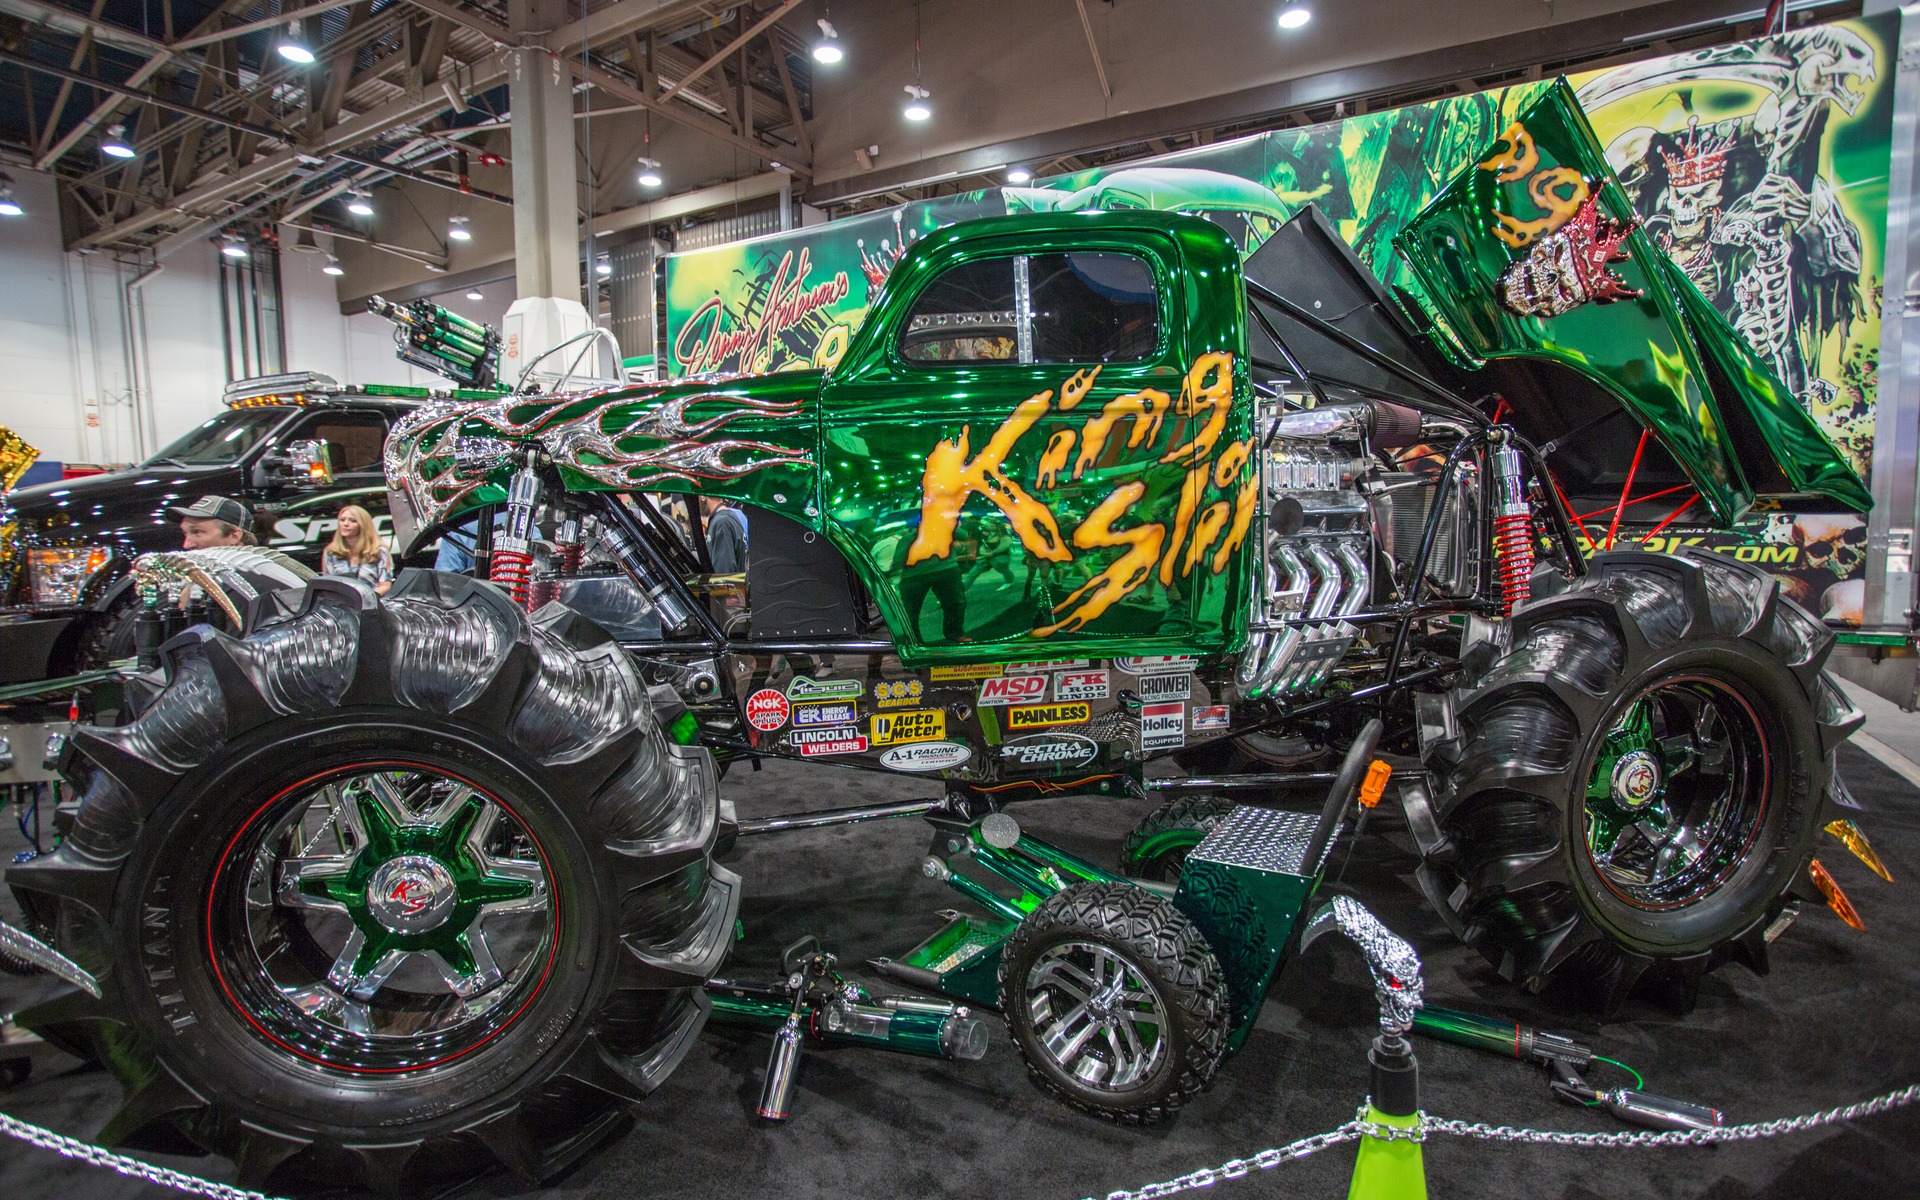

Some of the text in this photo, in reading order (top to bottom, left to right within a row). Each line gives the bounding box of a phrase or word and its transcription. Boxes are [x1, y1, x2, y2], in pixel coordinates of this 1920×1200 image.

[905, 350, 1234, 567] King
[953, 665, 1001, 673] SUSPENSIN
[1148, 665, 1191, 673] transmissions
[982, 676, 1045, 697] MSD
[1061, 673, 1107, 687] FK
[1140, 675, 1190, 695] CROWER
[877, 681, 922, 698] SCS
[1068, 684, 1107, 692] ROD
[877, 696, 922, 708] GEARBOX
[1057, 691, 1107, 701] ENDS
[1161, 691, 1190, 700] PRODUCTS
[753, 698, 782, 710] NGK
[821, 705, 849, 715] ENERGY
[755, 711, 781, 719] SPARK
[798, 707, 822, 724] ER
[822, 712, 851, 722] RELEASE
[893, 713, 934, 727] Auto
[1012, 705, 1087, 725] PAINLESS
[1143, 717, 1183, 732] Holley
[794, 729, 854, 744] LINCOLN
[889, 725, 943, 743] Meter
[1144, 736, 1182, 746] EQUIPPED
[807, 741, 860, 754] WELDERS
[889, 746, 960, 761] A-1 RACING
[1000, 741, 1082, 757] SPECTRA
[1020, 747, 1092, 763] CHROME
[143, 902, 199, 1036] TITAN
